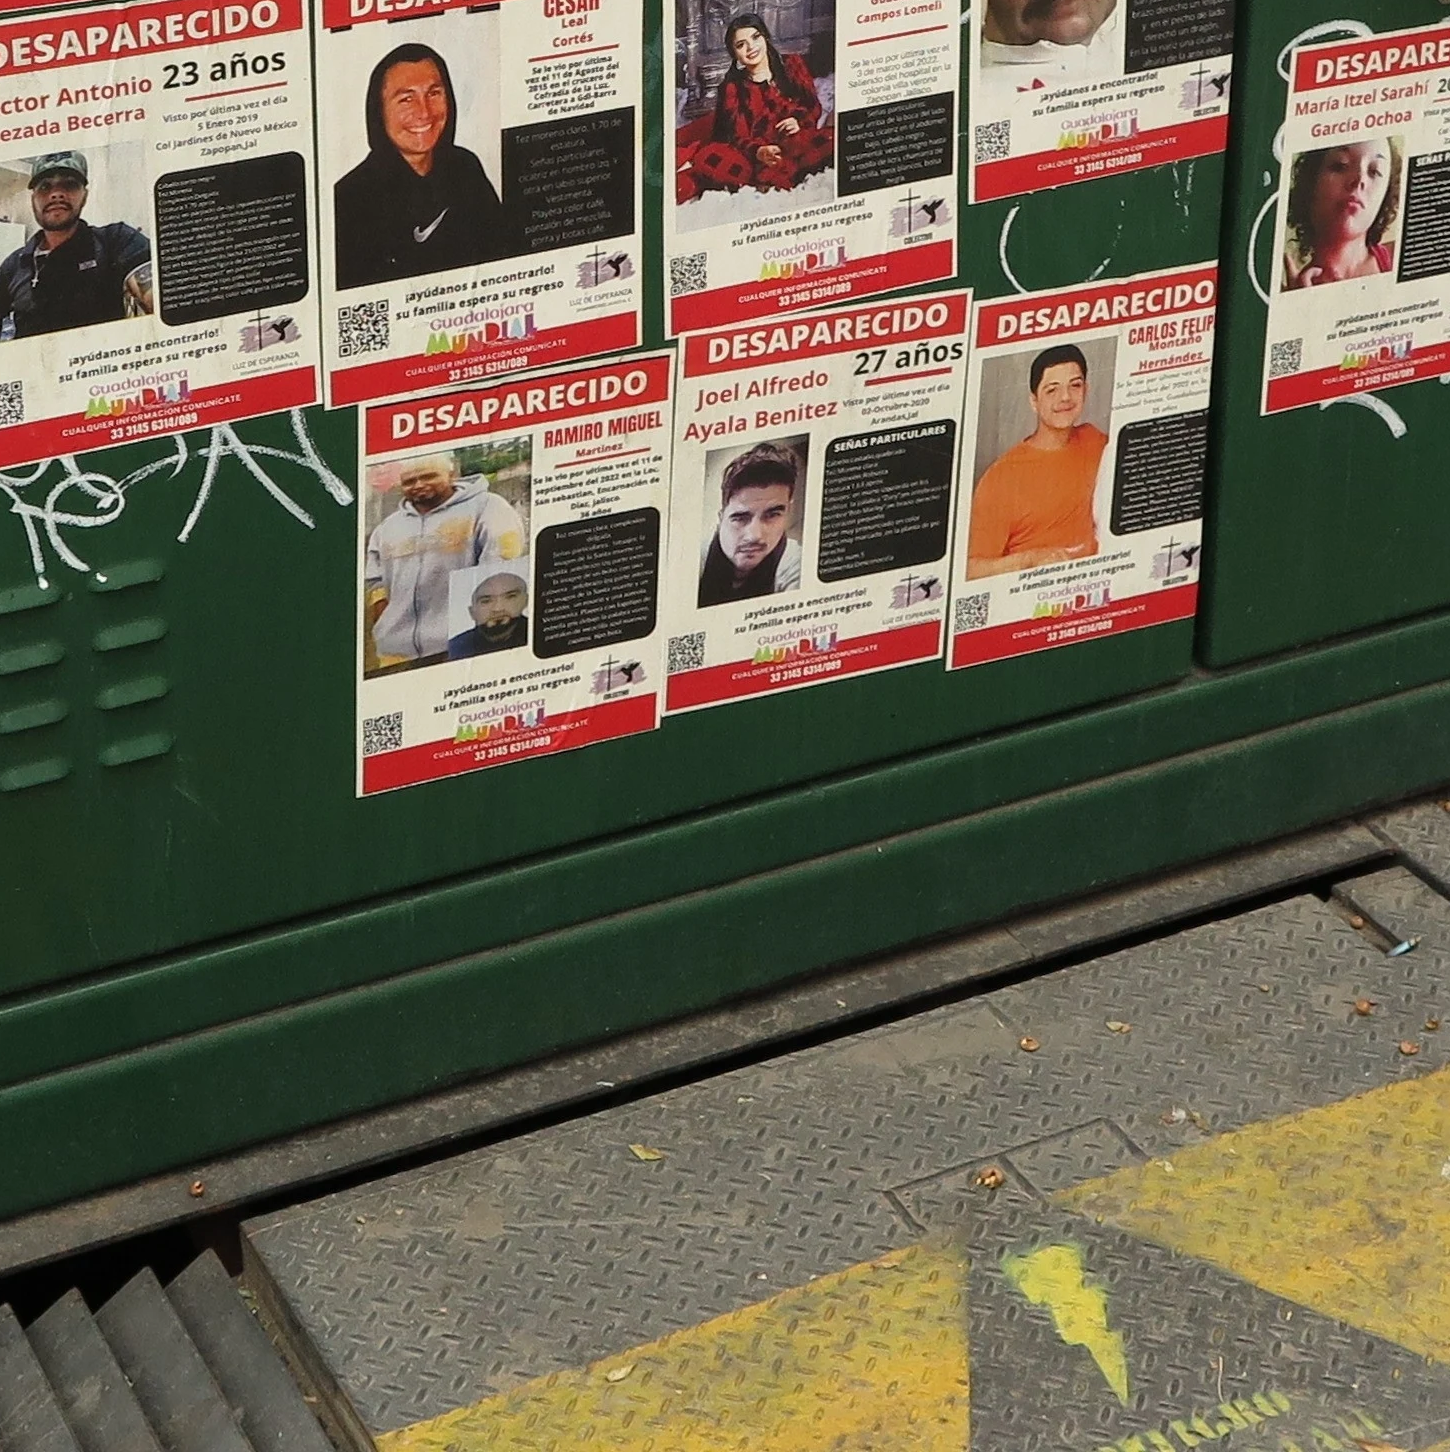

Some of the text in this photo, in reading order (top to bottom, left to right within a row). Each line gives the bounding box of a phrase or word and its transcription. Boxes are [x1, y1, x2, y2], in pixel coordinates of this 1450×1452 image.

[162, 49, 286, 90] 23 años
[56, 75, 152, 108] Antonio
[1294, 80, 1429, 117] María Itzel Sarahí
[997, 279, 1215, 339] DESAPARECIDO
[707, 303, 948, 364] DESAPARECIDO
[852, 340, 963, 377] 27 años
[391, 370, 647, 440] DESAPARECIDO
[695, 369, 829, 412] Joel Alfredo
